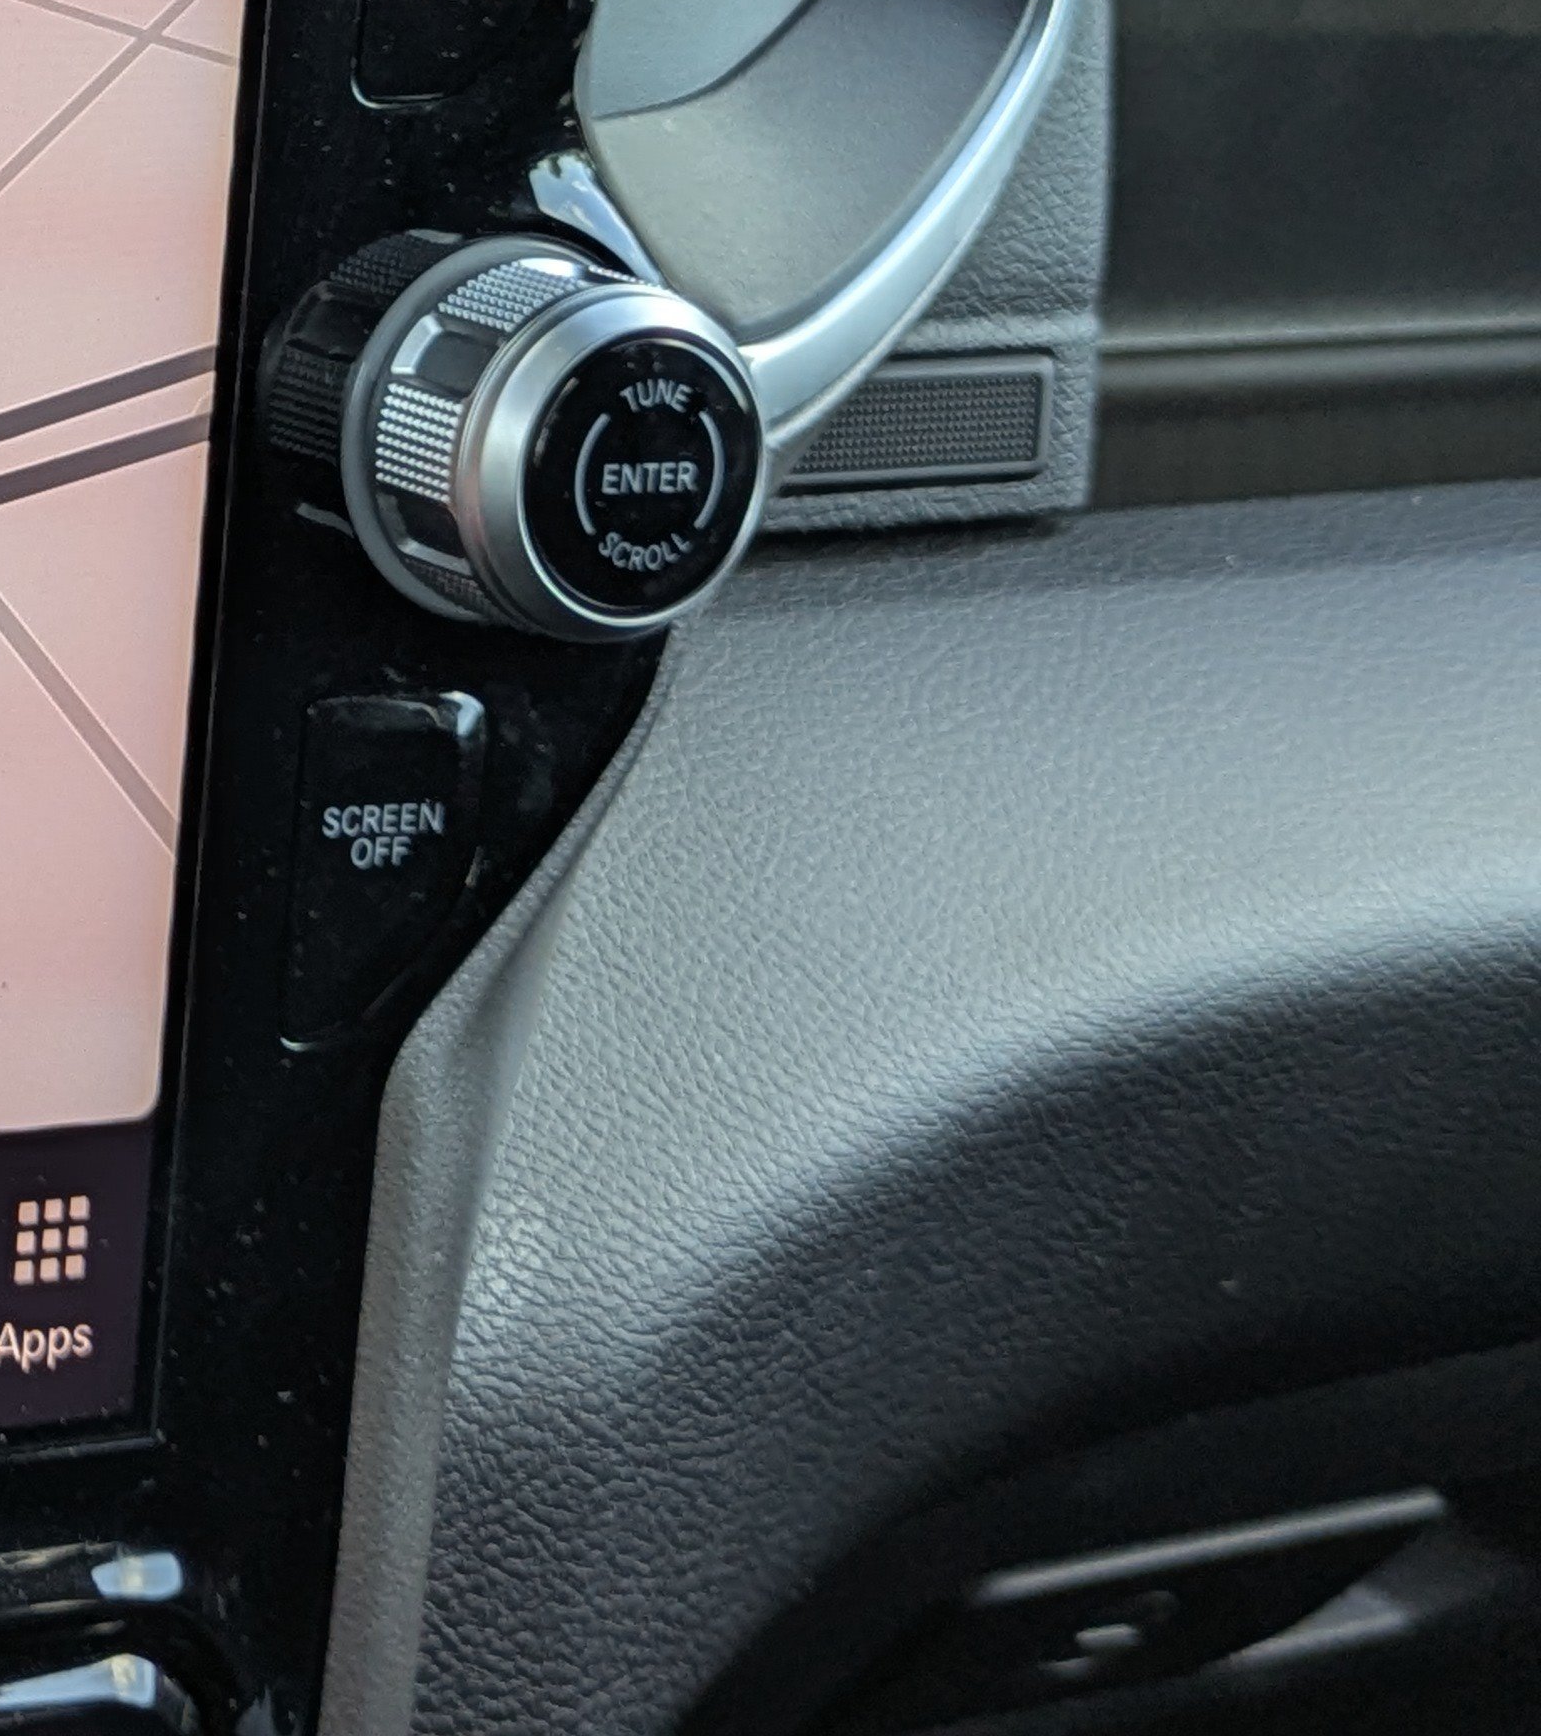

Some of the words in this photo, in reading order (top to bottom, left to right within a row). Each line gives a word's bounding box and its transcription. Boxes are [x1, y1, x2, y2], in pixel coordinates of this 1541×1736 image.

[620, 378, 692, 415] TUNE
[601, 460, 699, 497] ENTER
[598, 531, 692, 573] SCROLL
[322, 801, 445, 839] SCREEN
[350, 837, 412, 869] OFF
